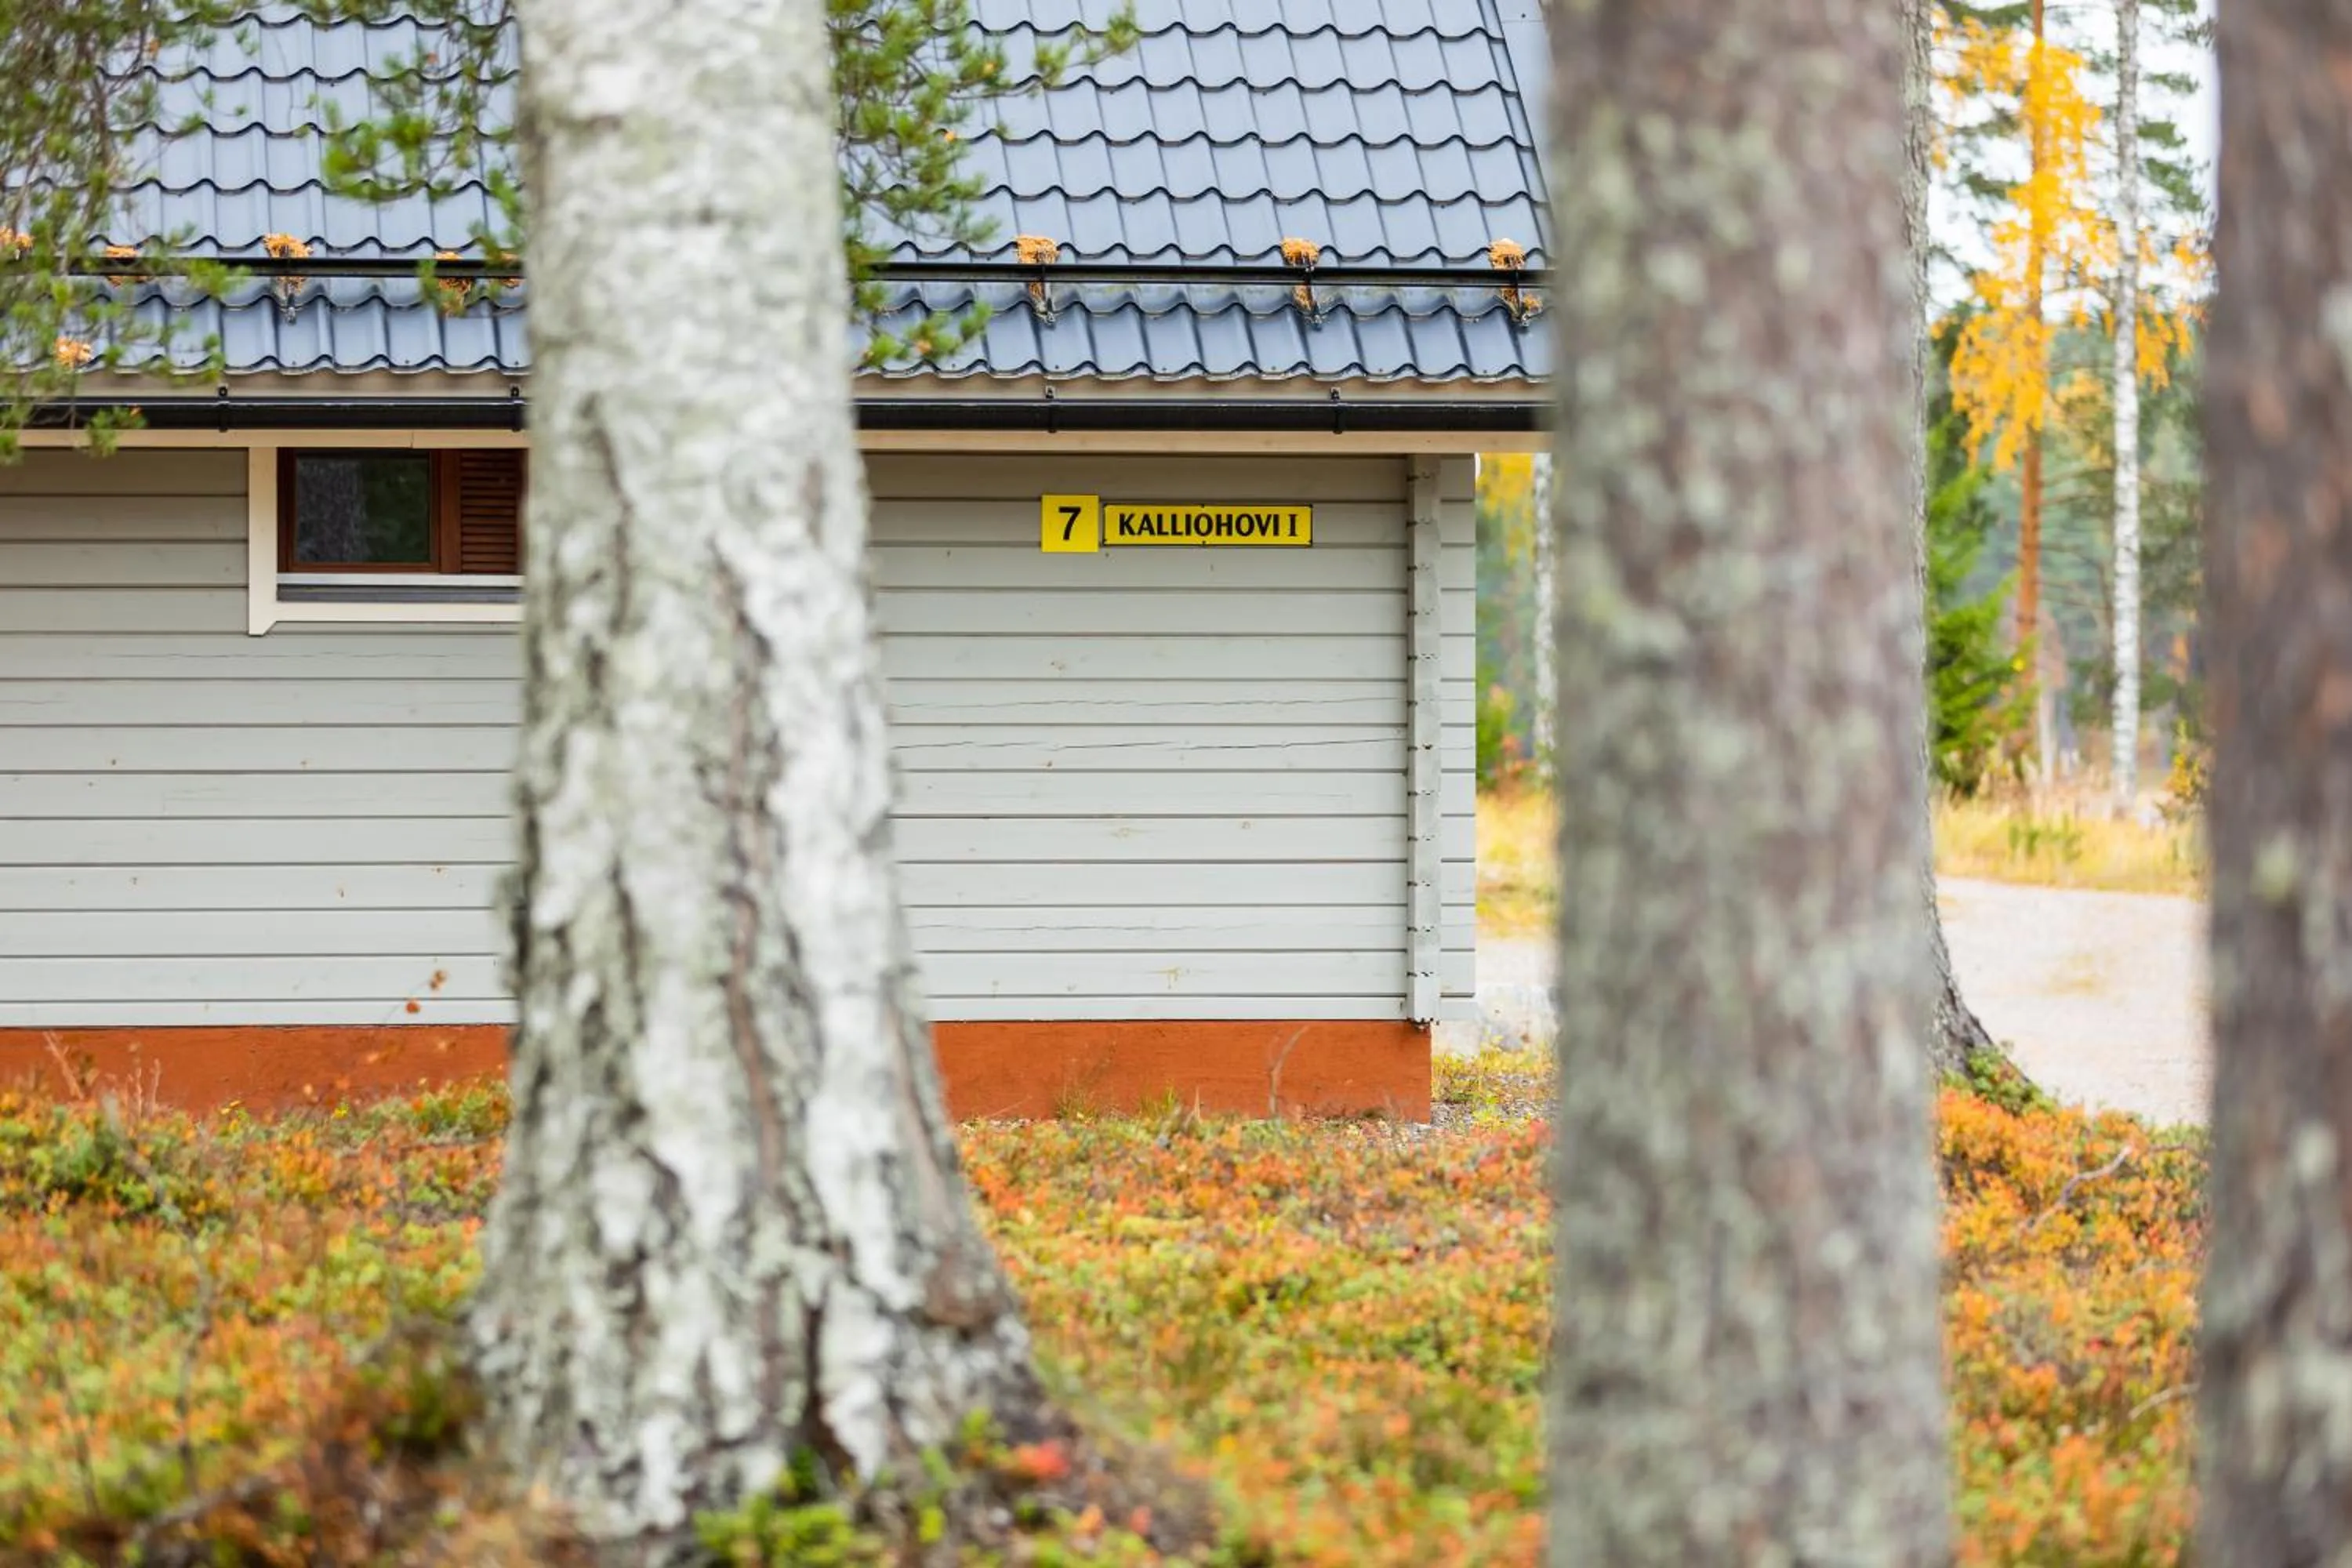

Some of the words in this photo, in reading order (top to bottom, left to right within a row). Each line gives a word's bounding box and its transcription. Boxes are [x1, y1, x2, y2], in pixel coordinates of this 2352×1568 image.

[1058, 506, 1082, 541] 7
[1119, 513, 1279, 537] KALLIOHOVI
[1288, 514, 1298, 537] I
